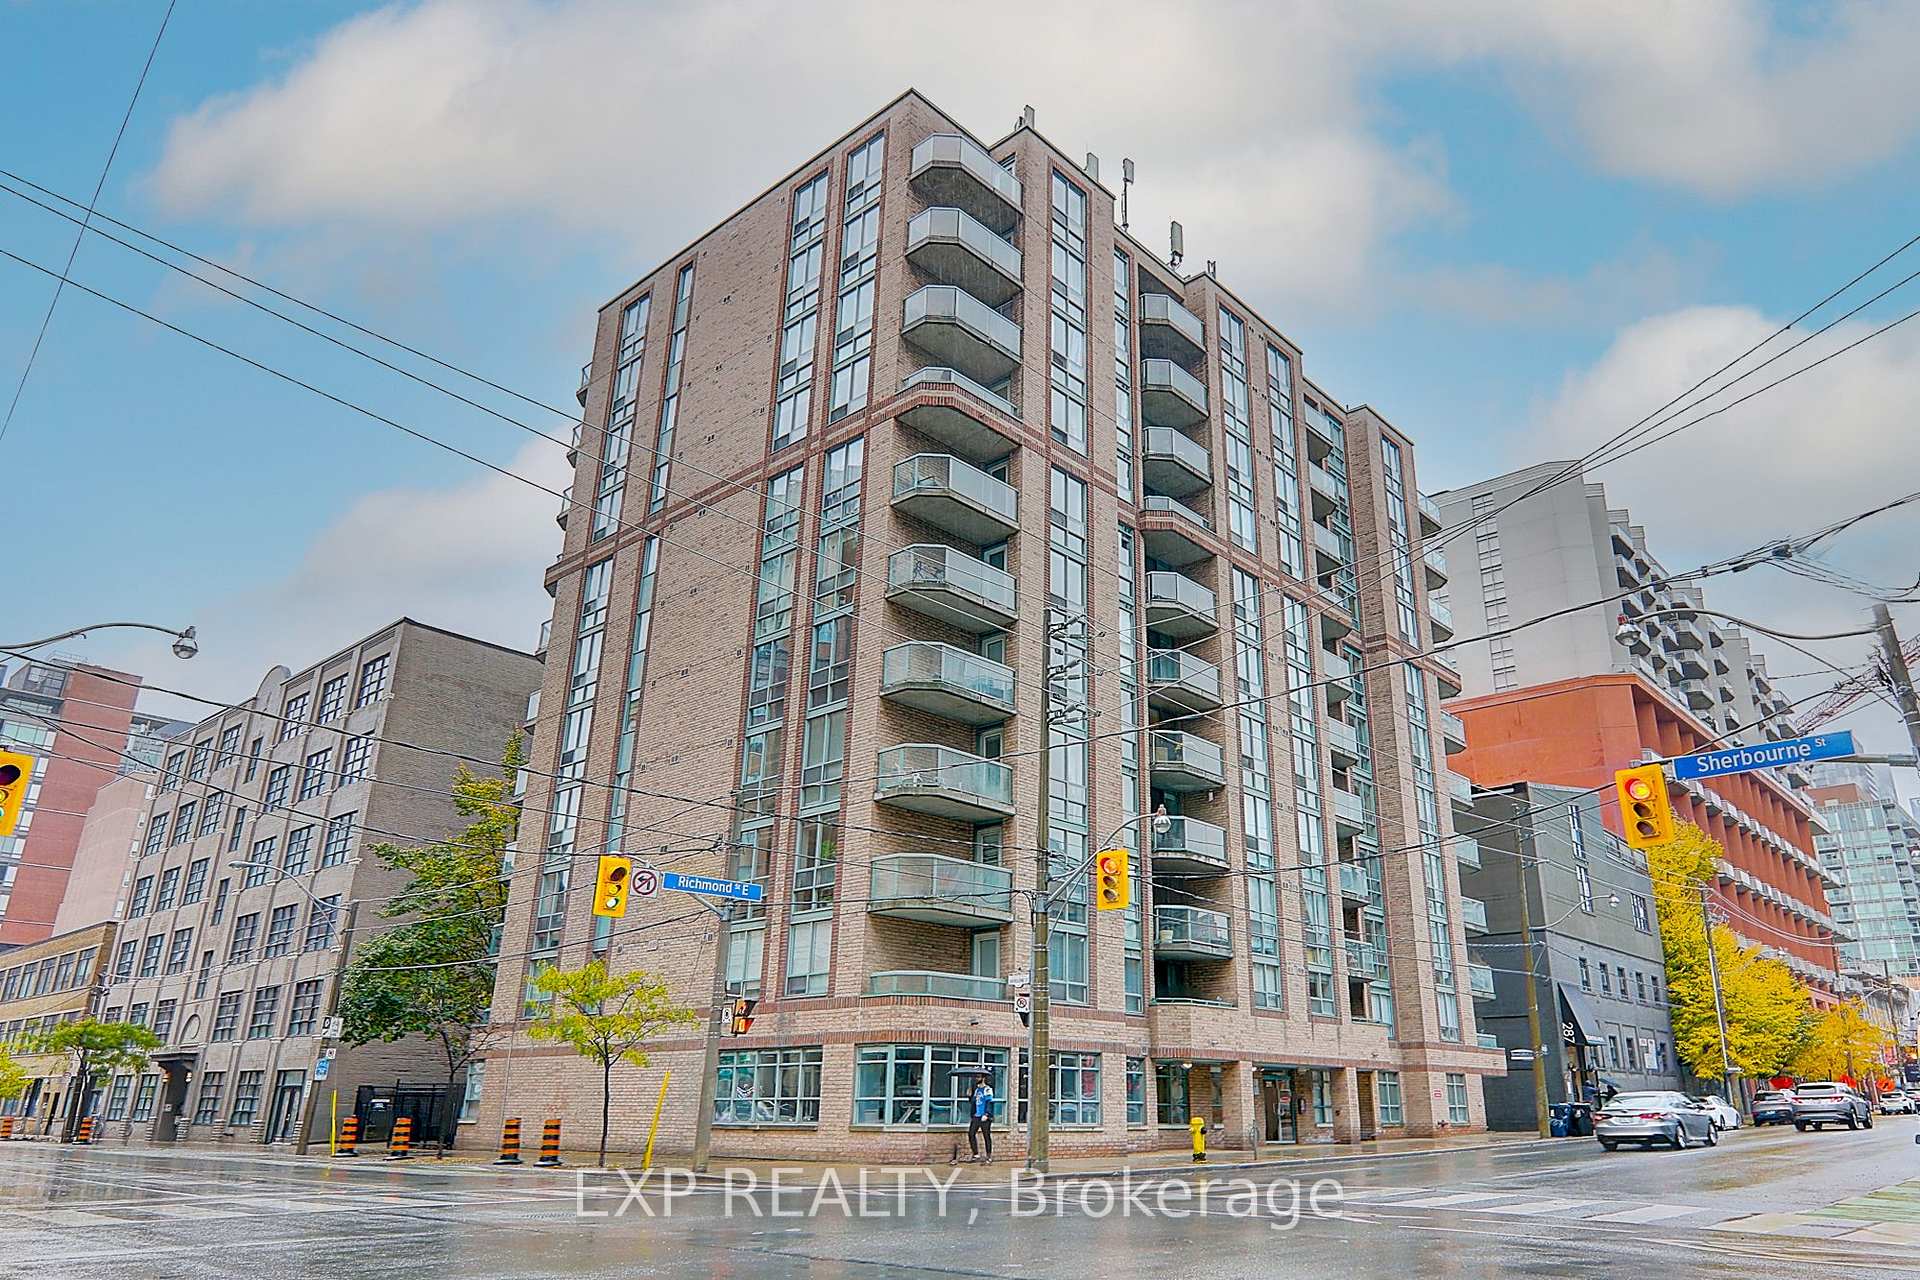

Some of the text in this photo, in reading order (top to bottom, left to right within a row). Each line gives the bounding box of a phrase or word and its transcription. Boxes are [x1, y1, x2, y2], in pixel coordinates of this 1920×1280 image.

[1697, 737, 1827, 773] Sherbourne St
[678, 875, 733, 893] Richmond
[742, 884, 749, 896] E
[1561, 1022, 1576, 1044] 287
